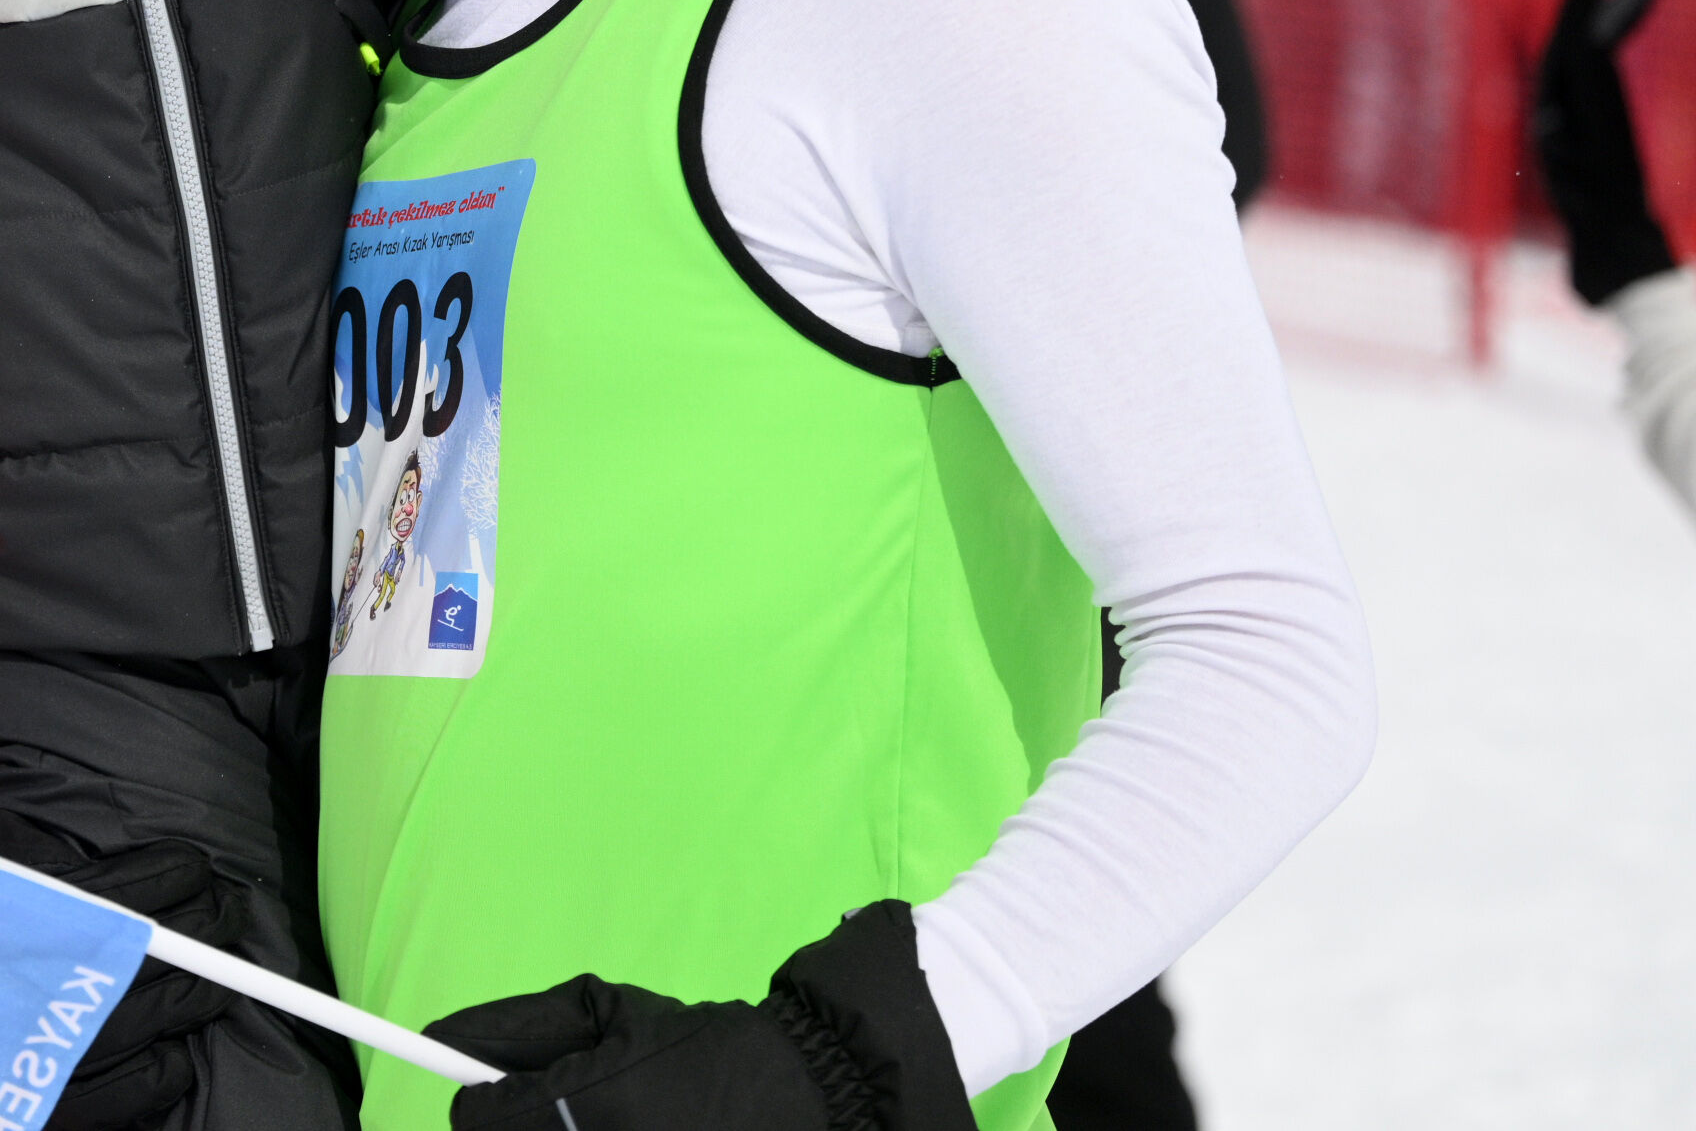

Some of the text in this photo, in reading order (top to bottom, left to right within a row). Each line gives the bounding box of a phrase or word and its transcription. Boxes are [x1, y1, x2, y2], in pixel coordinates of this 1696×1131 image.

[388, 199, 456, 229] çekilmez
[348, 229, 475, 263] Eşler Arası Kızak Yarışması
[330, 271, 473, 448] 003
